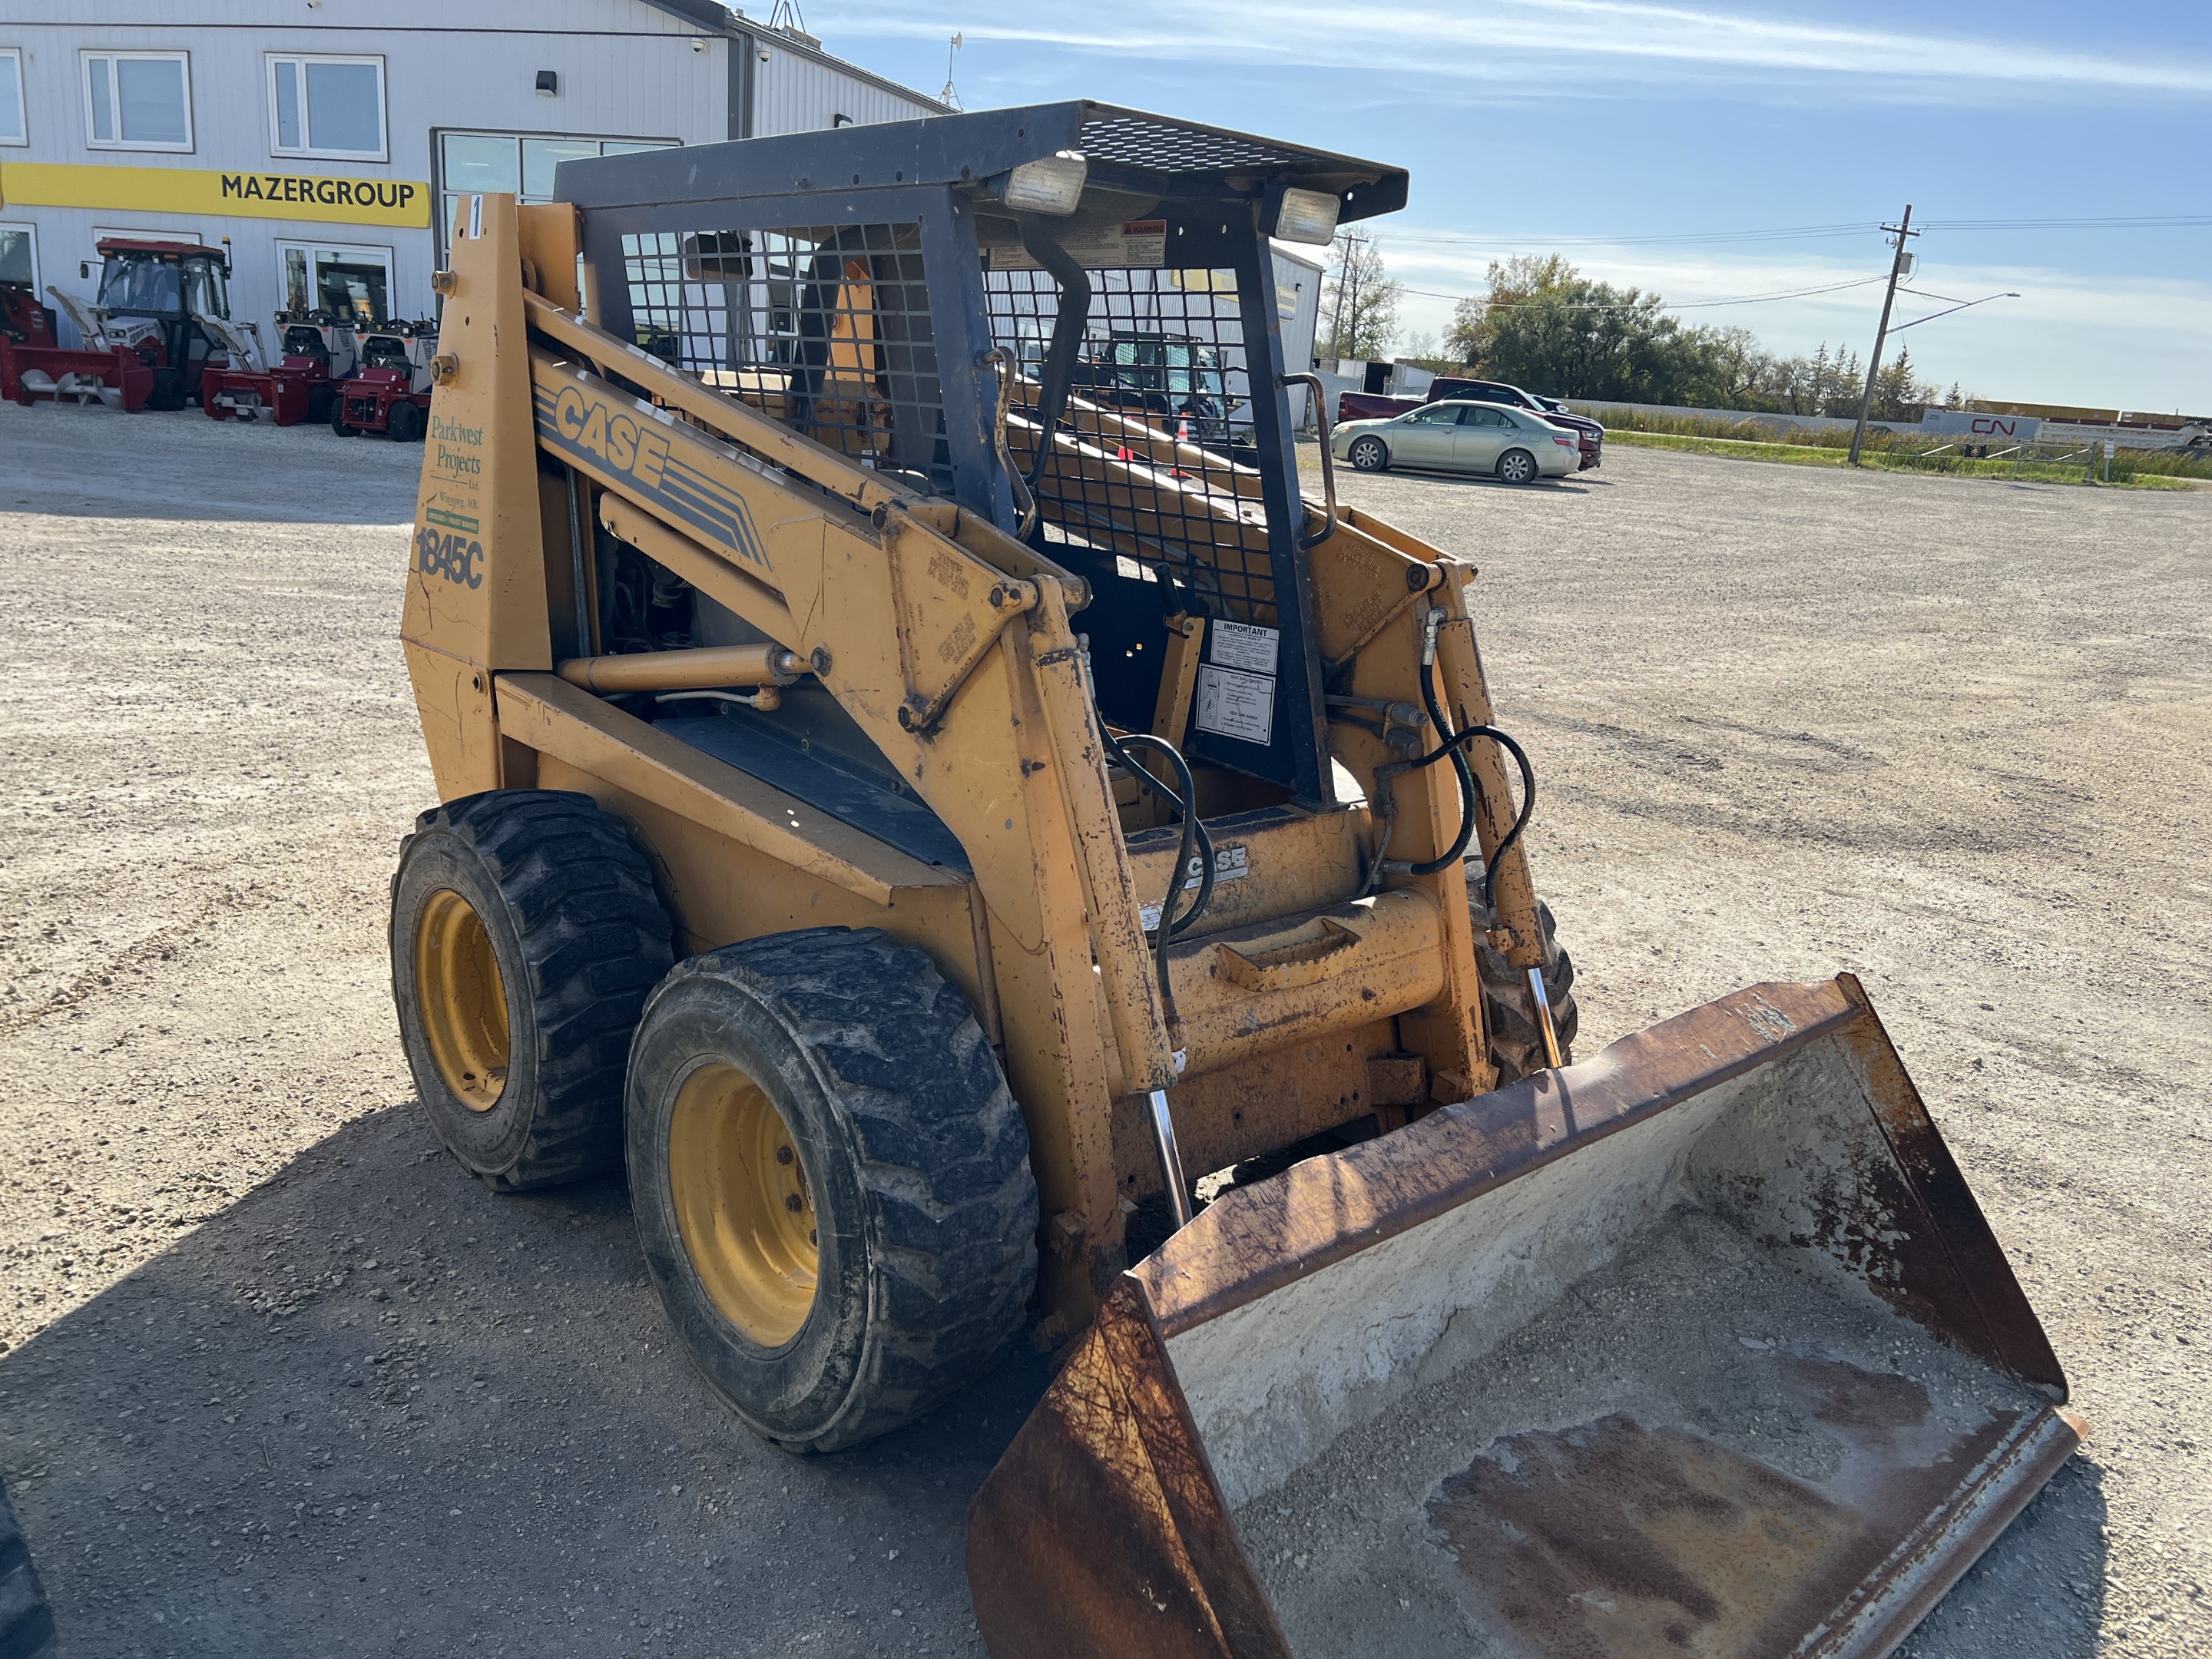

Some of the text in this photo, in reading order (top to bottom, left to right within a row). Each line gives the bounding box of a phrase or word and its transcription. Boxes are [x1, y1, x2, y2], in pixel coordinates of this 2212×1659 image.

[221, 174, 414, 208] MAZERGROUP
[474, 197, 480, 236] 1
[1132, 224, 1164, 233] WARNING
[432, 415, 483, 445] Parkwest
[556, 386, 670, 491] CASE
[1972, 419, 2016, 436] CN
[436, 444, 481, 478] Projects
[416, 527, 483, 590] 1845C
[1224, 623, 1268, 637] IMPORTANT
[1187, 847, 1246, 876] CSE
